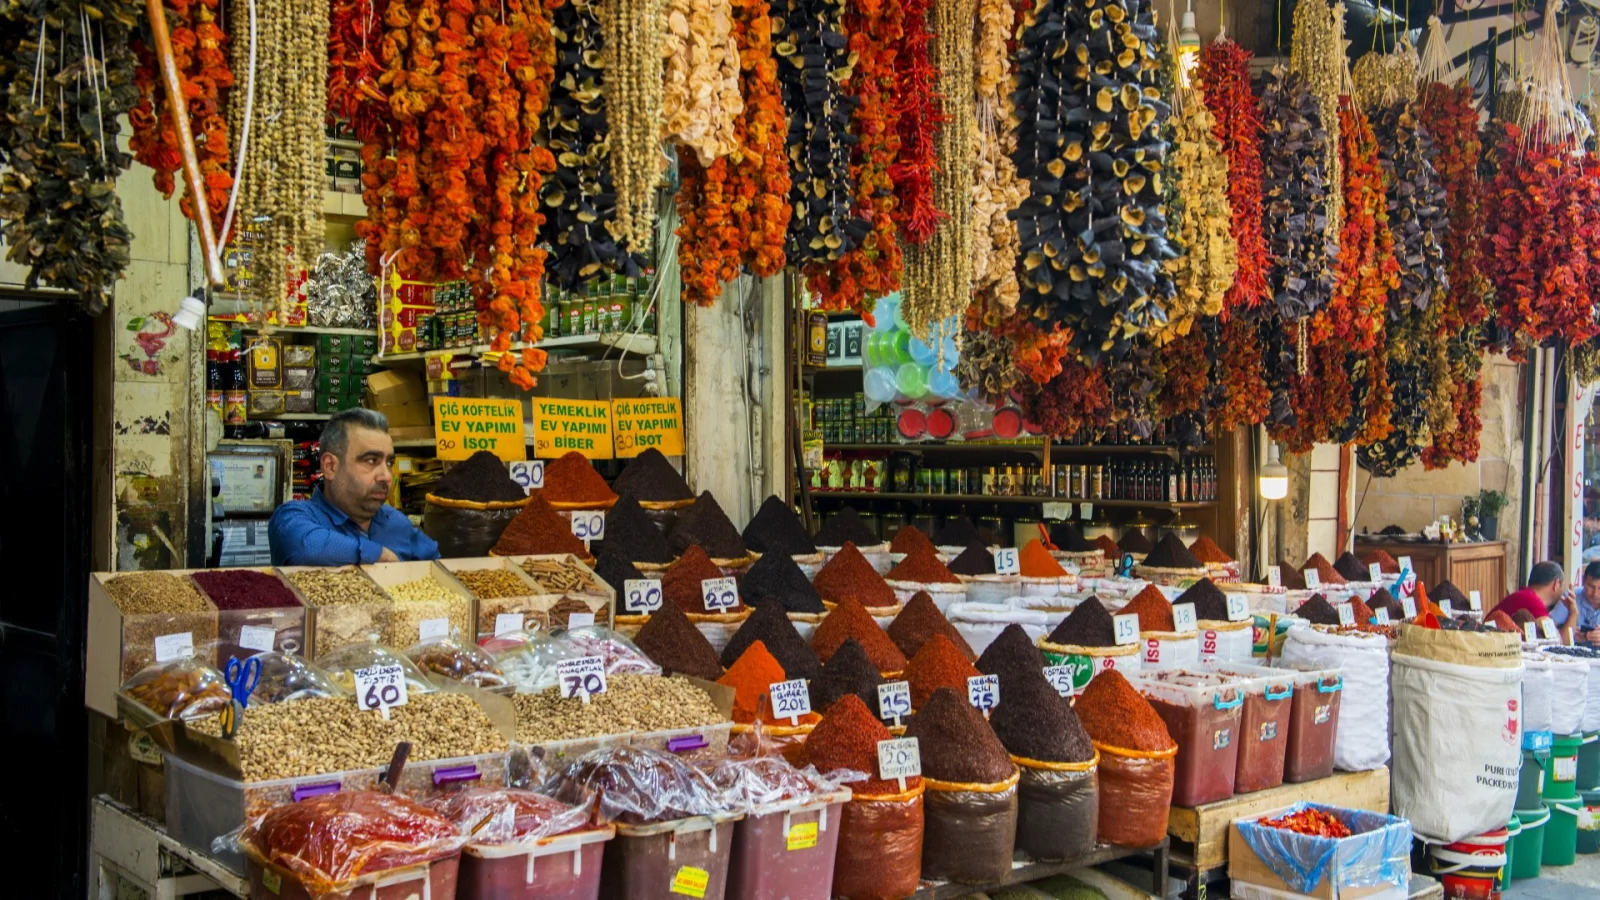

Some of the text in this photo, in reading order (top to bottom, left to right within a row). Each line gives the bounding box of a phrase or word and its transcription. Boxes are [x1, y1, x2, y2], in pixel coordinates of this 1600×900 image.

[440, 402, 458, 418] ÇİĞ
[540, 404, 606, 418] YEMEKLİK
[616, 402, 630, 417] ÇİĞ
[442, 420, 516, 434] EV YAPIMI
[541, 420, 606, 434] EV YAPIMI
[618, 418, 677, 431] EV YAPIMI
[463, 435, 497, 450] İSOT
[554, 436, 594, 449] BİBER
[634, 434, 662, 446] İSOT
[512, 463, 542, 487] 30
[574, 515, 603, 537] 30
[998, 550, 1014, 570] 15
[630, 588, 660, 608] 20
[706, 591, 734, 608] 20
[1230, 596, 1244, 614] 15
[1178, 610, 1190, 624] 18
[1119, 620, 1134, 638] 15
[564, 674, 602, 699] 70
[365, 684, 399, 708] 60
[883, 692, 909, 716] 15
[974, 692, 994, 710] 15
[1476, 776, 1507, 788] PACKED
